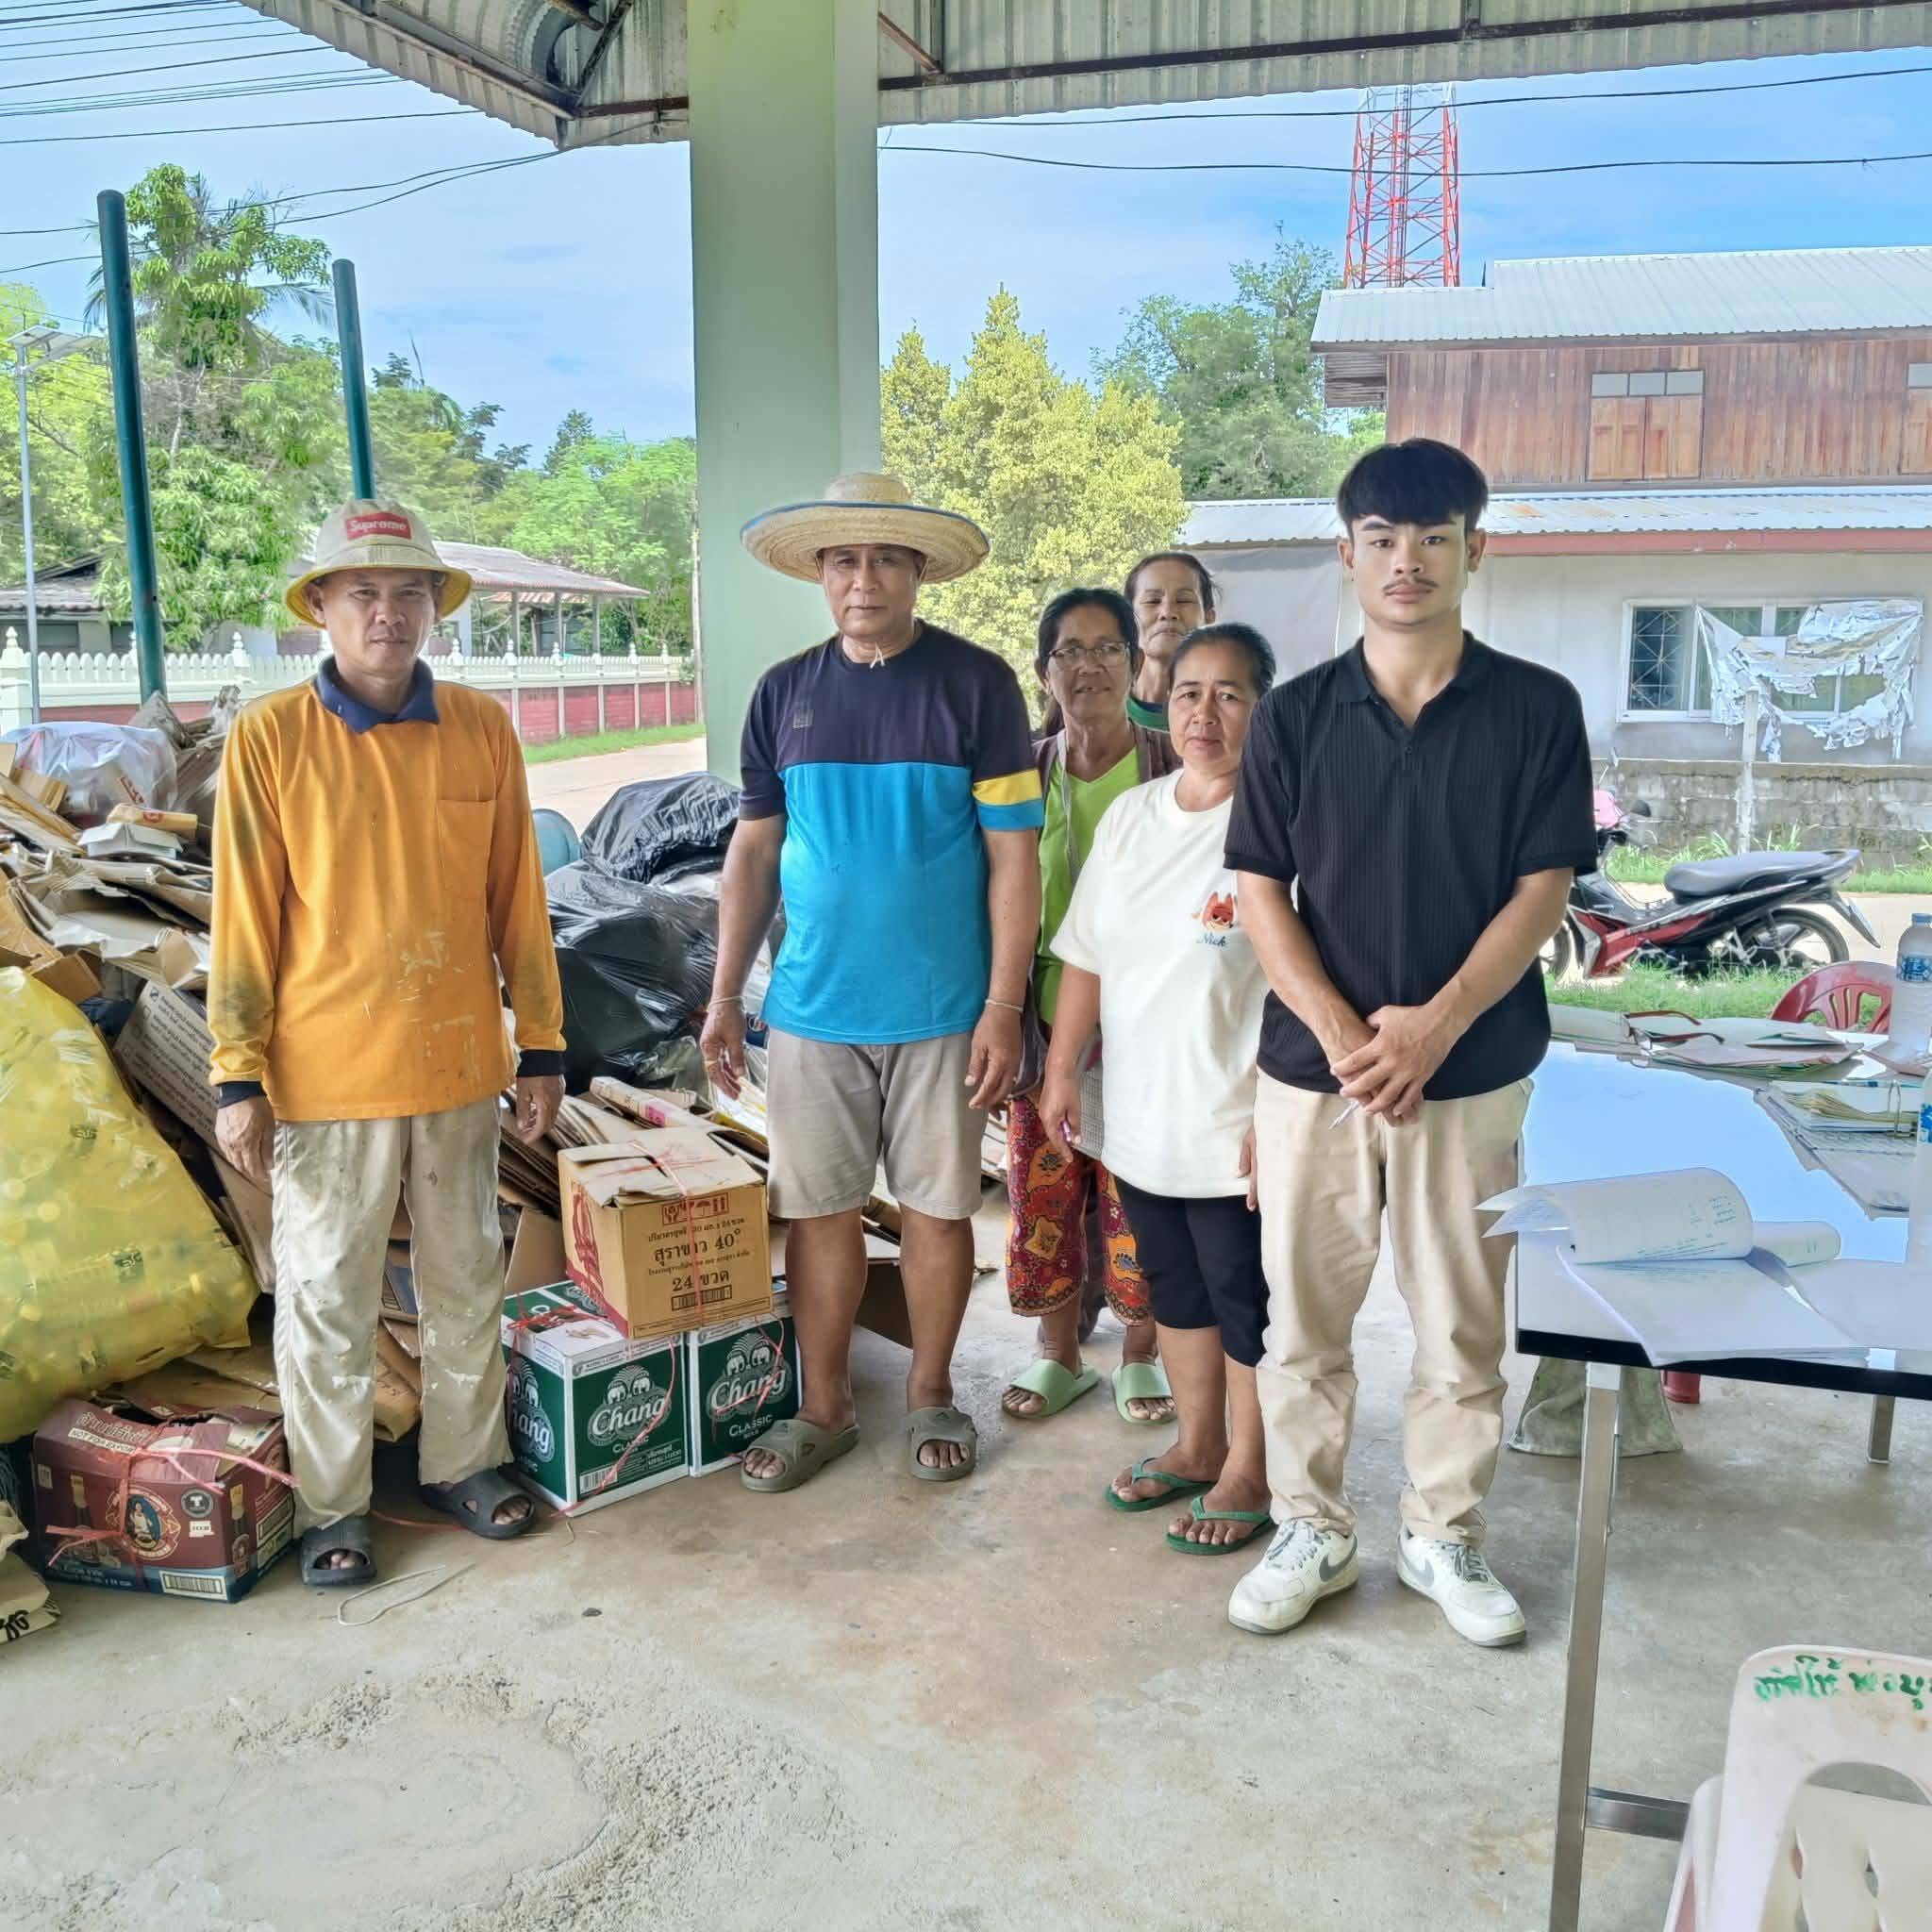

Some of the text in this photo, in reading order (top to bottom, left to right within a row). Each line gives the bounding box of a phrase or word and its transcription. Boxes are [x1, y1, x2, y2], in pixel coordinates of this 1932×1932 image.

[654, 1240, 708, 1267] สุราขาว
[672, 1269, 730, 1292] 24 ขวด
[710, 1369, 787, 1410] Chang
[728, 1414, 774, 1438] CLASSIC
